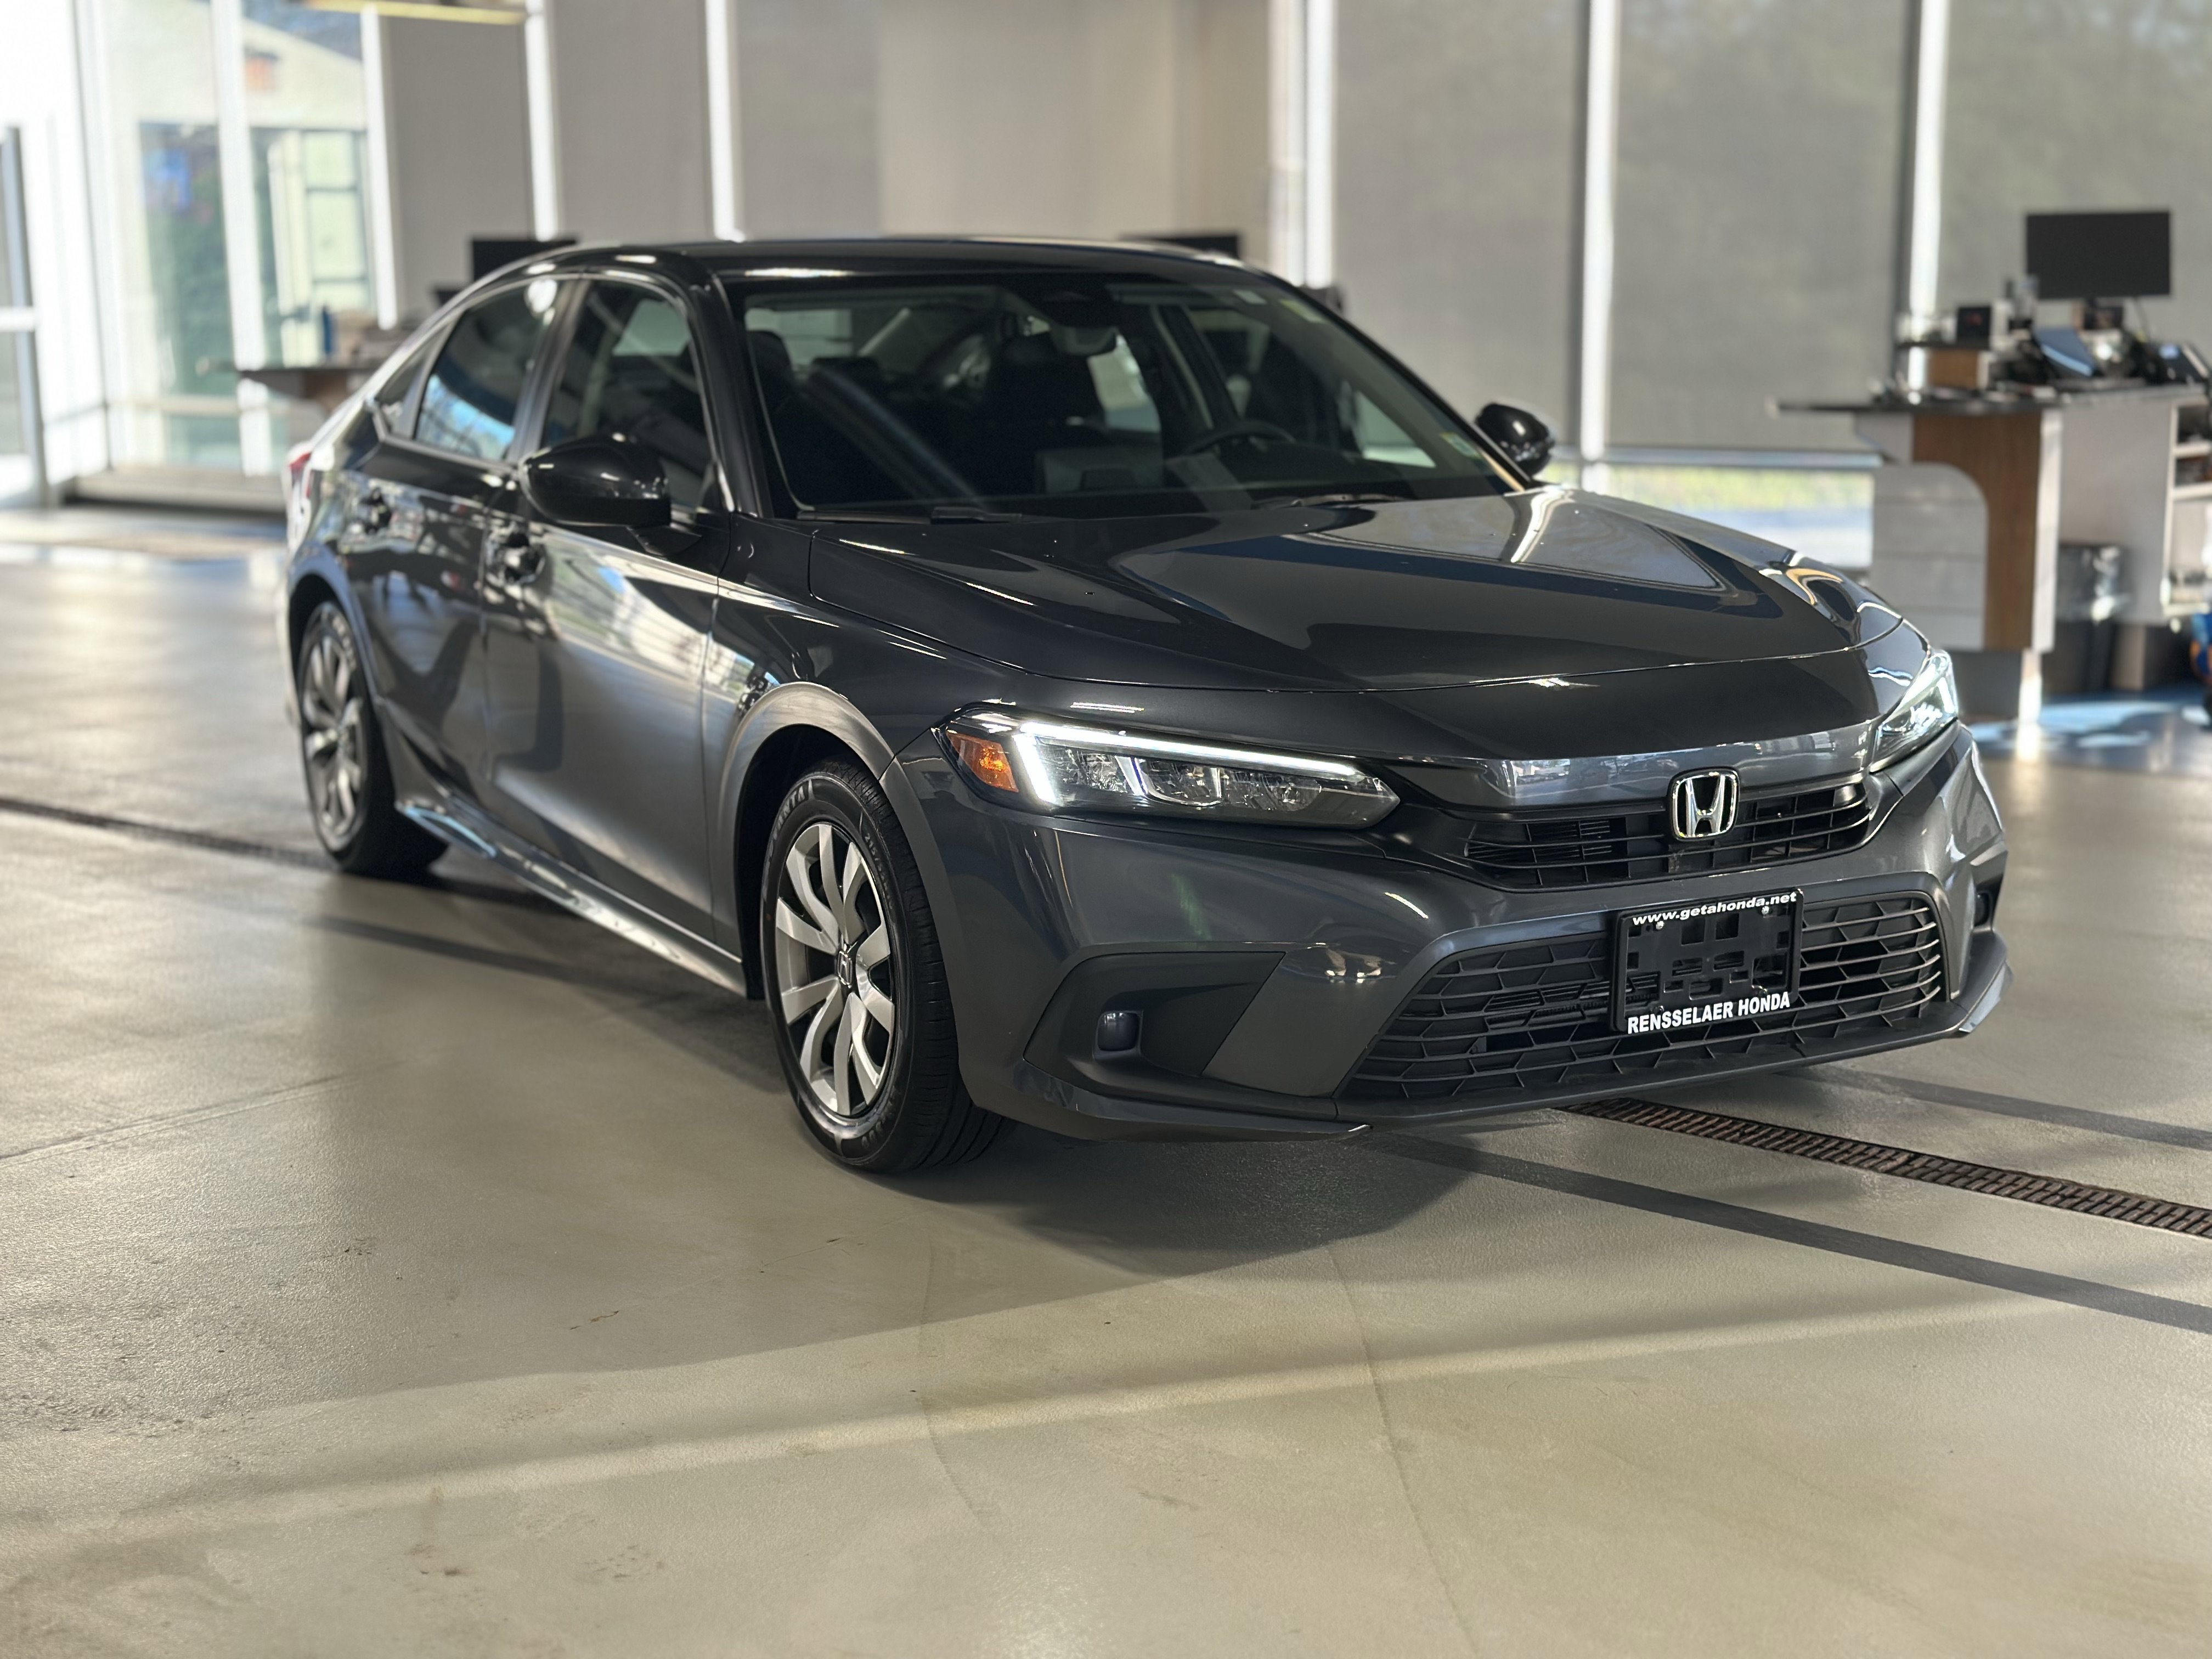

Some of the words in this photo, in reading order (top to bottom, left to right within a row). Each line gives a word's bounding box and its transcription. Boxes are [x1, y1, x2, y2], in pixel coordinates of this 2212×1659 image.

[1632, 891, 1797, 926] www.getahonda.net
[1628, 1001, 1734, 1034] RENSSELAER
[1738, 991, 1790, 1017] HONDA
